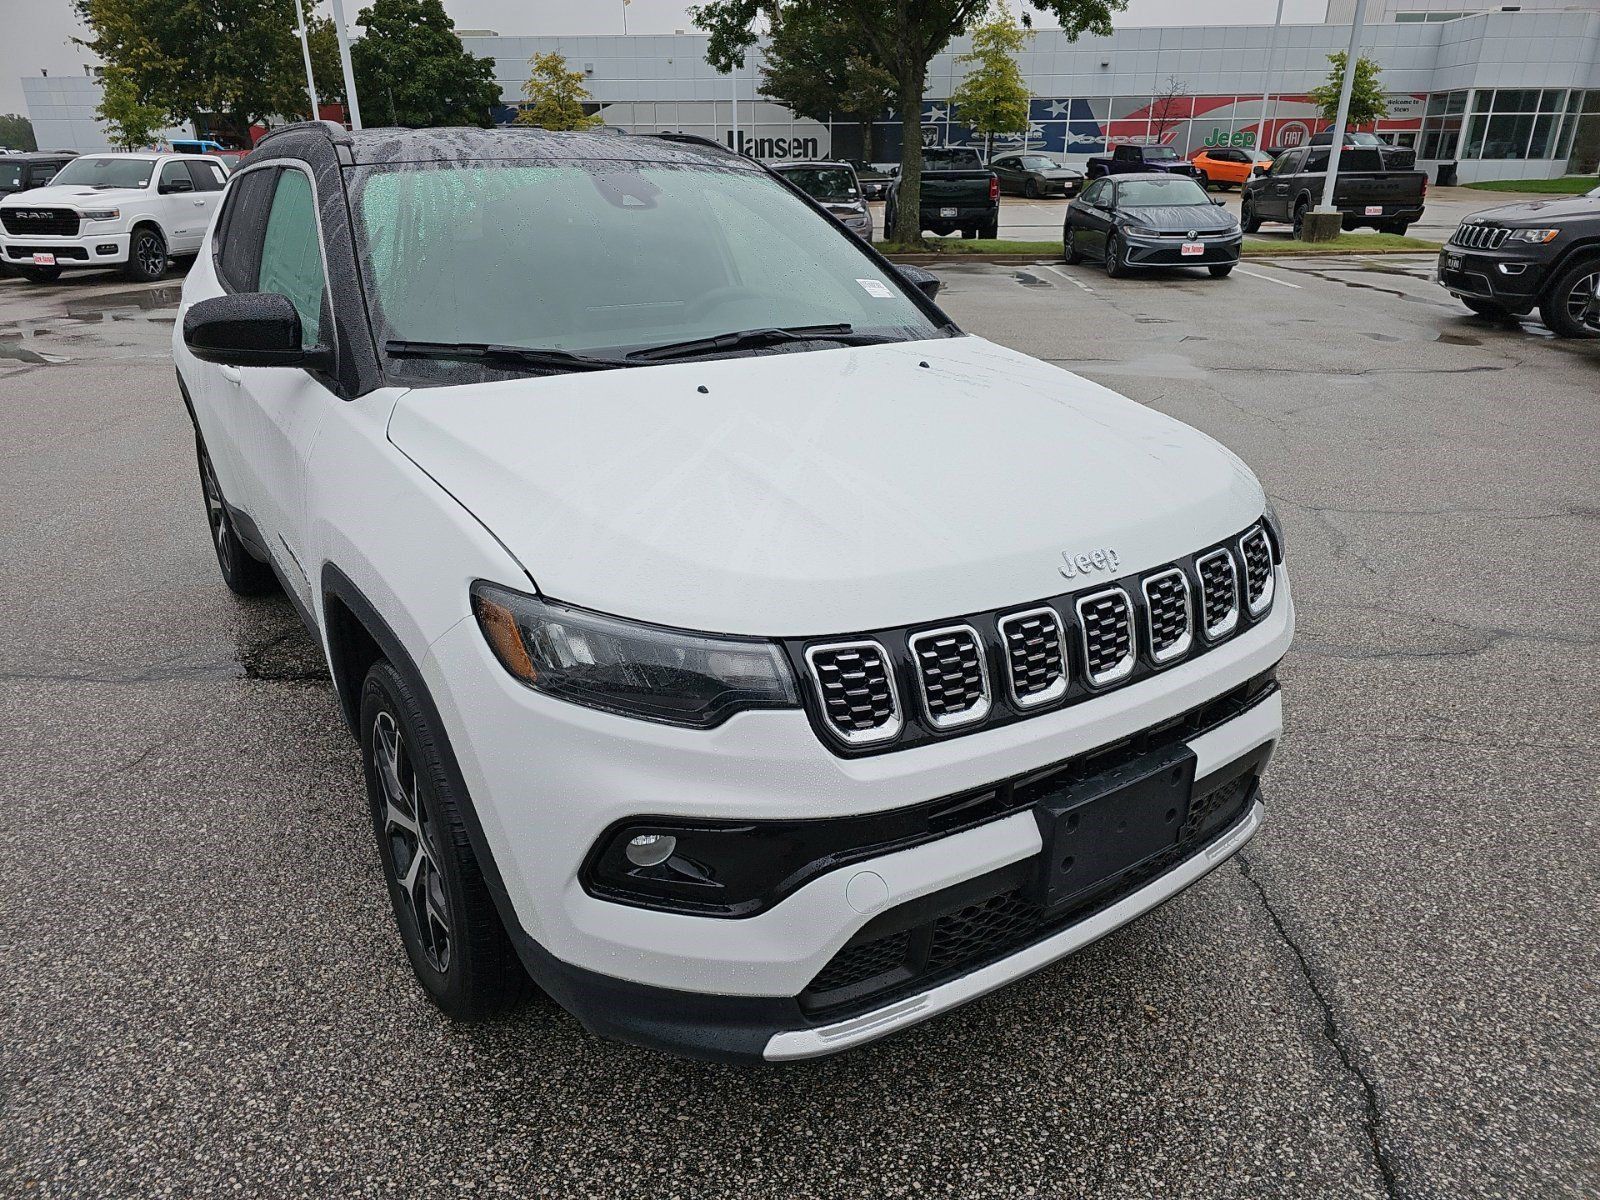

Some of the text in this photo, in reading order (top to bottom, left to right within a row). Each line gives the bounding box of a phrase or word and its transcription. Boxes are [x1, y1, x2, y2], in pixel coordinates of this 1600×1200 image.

[727, 130, 818, 158] Hansen
[1079, 135, 1159, 144] DODGE
[1203, 127, 1257, 147] Jeep
[1284, 131, 1302, 145] FIAT
[15, 211, 54, 219] RAM
[1058, 547, 1120, 579] Jeep
